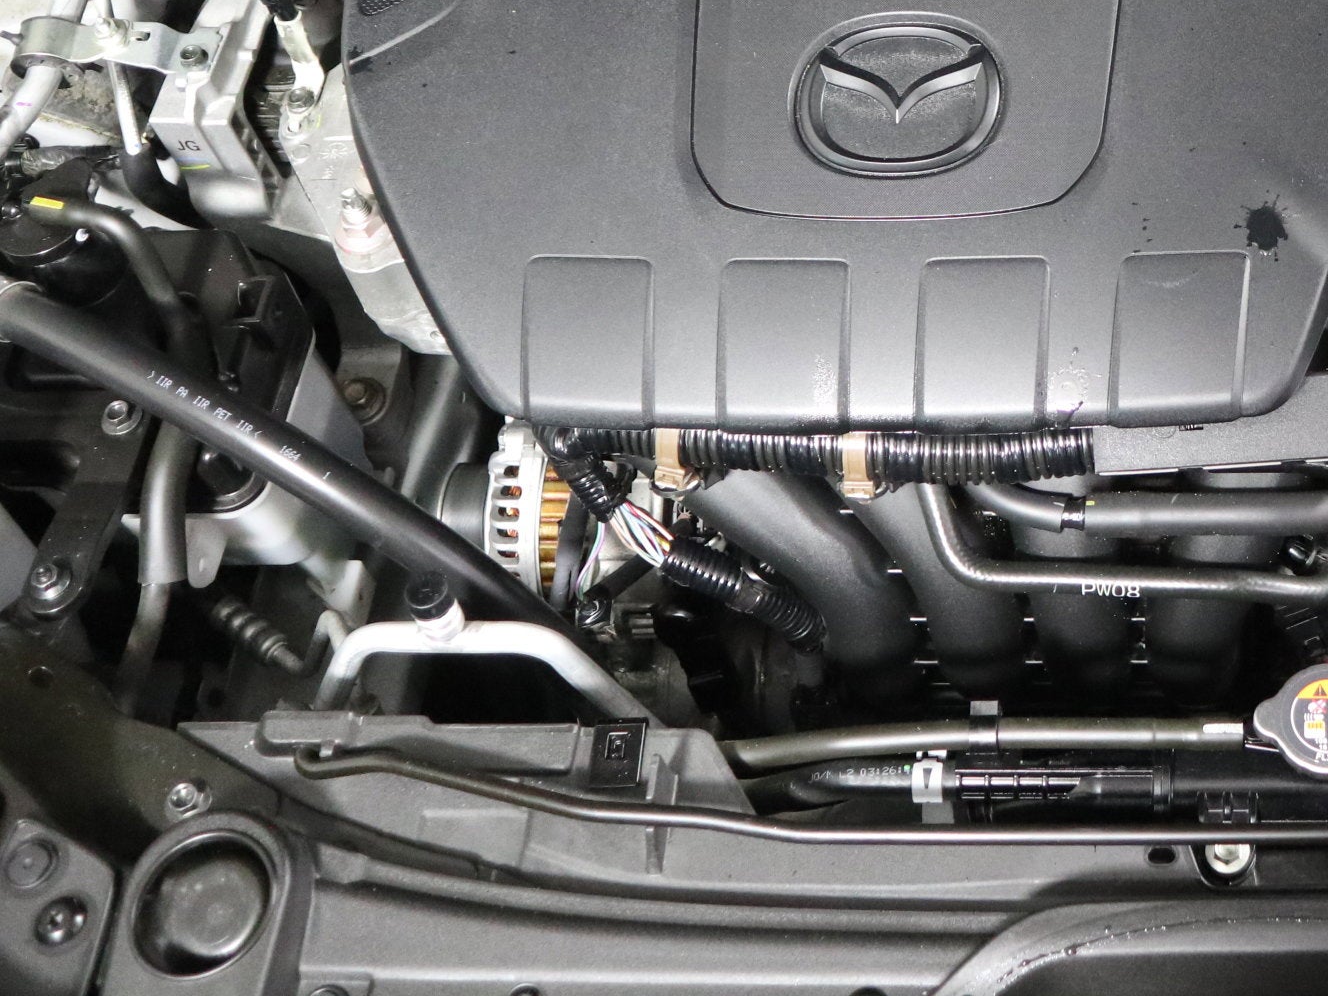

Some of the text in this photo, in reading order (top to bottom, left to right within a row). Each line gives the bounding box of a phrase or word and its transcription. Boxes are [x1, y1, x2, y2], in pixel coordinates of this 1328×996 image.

[177, 140, 201, 151] JG
[176, 386, 189, 398] PA
[213, 407, 232, 421] PET
